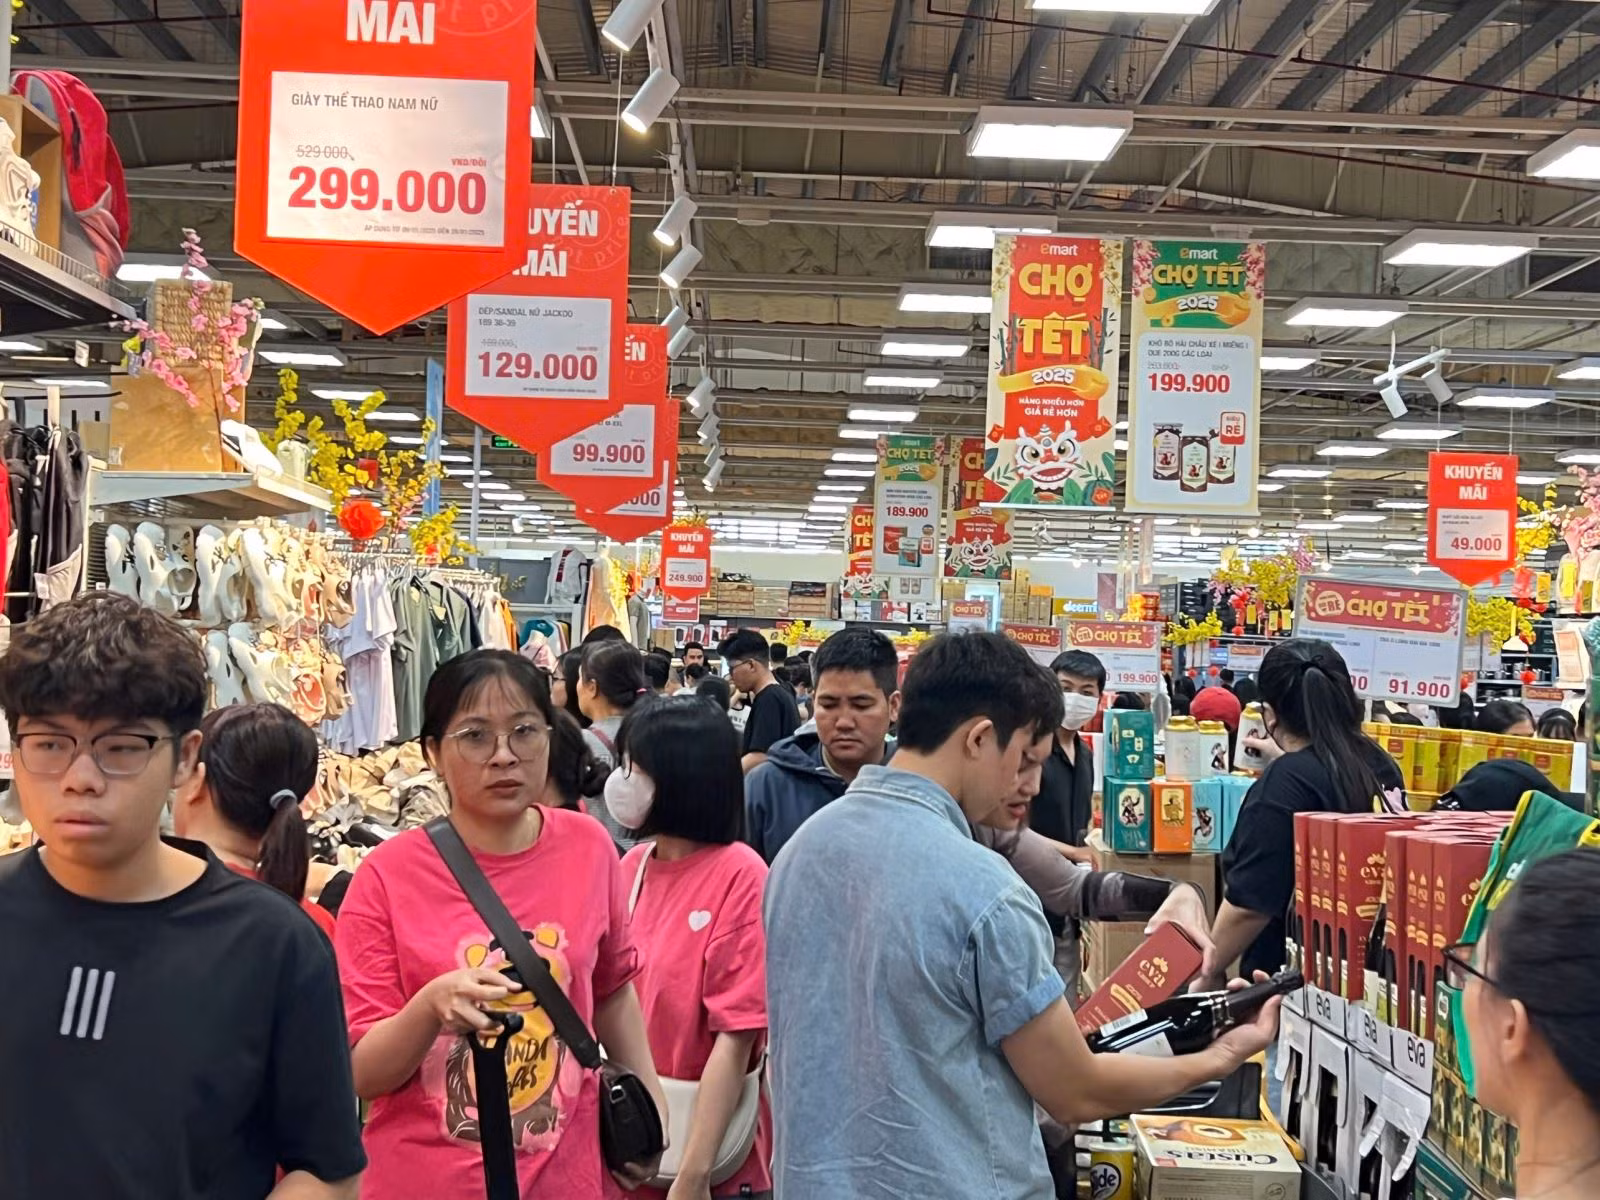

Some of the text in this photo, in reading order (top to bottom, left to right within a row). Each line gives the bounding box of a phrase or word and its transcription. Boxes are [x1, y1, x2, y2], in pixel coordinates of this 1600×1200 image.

[291, 91, 320, 106] GIÀY
[351, 95, 384, 109] THAO
[388, 97, 417, 110] NAM
[421, 96, 438, 111] NỮ
[288, 165, 486, 215] 299.000
[528, 200, 598, 238] UYẾN
[1040, 243, 1078, 256] emart
[1180, 247, 1218, 260] emart
[1018, 262, 1093, 303] CHỢ
[1153, 261, 1245, 289] CHỢ TẾT
[1176, 295, 1219, 311] 2025
[1016, 311, 1090, 355] TẾT
[478, 351, 598, 381] 129.000
[1031, 368, 1076, 385] 2025
[1148, 372, 1230, 393] 199.900
[573, 443, 646, 464] 99.900
[1444, 462, 1503, 480] KHUYẾN
[1458, 483, 1488, 500] MÃI
[886, 506, 929, 518] 189.900
[1450, 537, 1502, 551] 49.000
[1346, 598, 1430, 625] CHỢ TẾT
[1118, 673, 1158, 683] 199.900
[1388, 678, 1450, 698] 91.900
[1139, 959, 1166, 988] eva
[1407, 1036, 1426, 1069] eva
[1167, 1149, 1278, 1166] Custas
